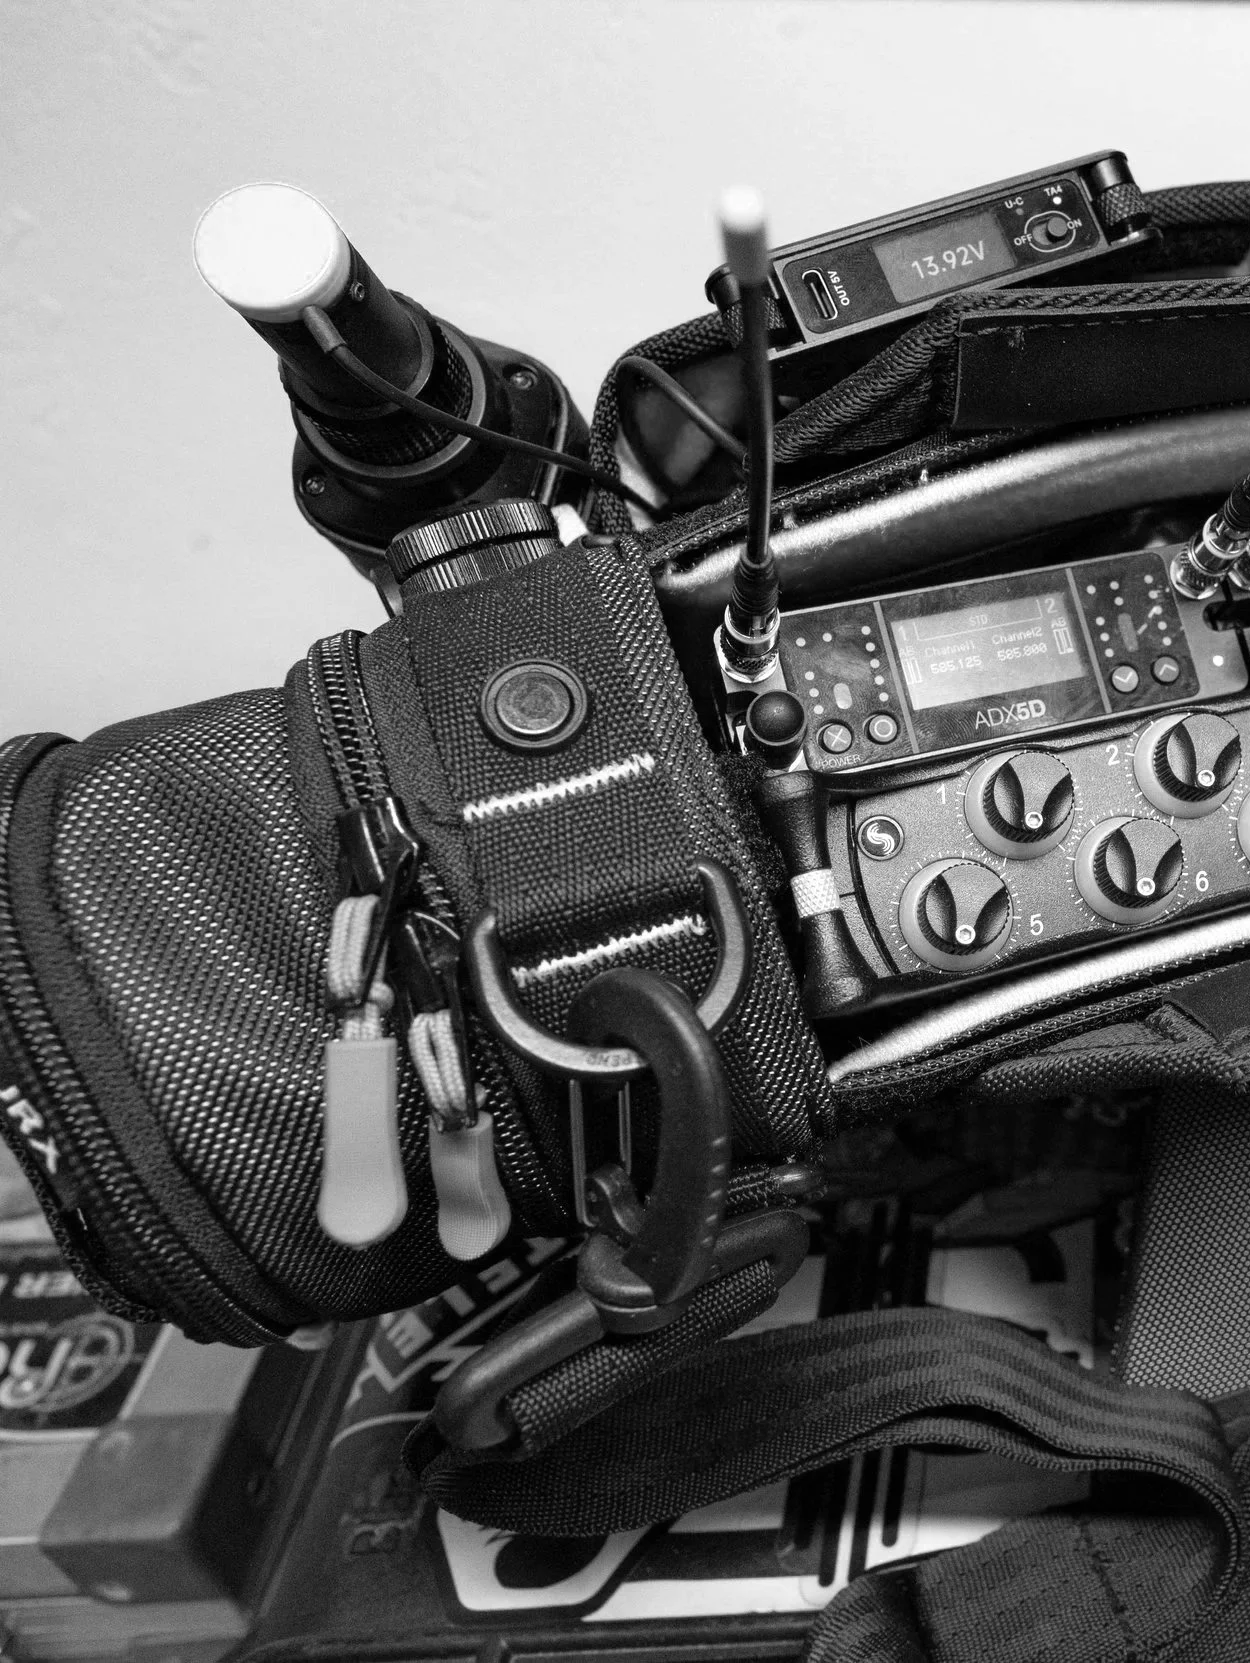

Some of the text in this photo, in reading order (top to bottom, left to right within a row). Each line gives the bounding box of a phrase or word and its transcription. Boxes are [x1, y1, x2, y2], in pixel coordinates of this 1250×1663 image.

[1043, 184, 1063, 197] TA4
[1004, 196, 1024, 210] U-C
[1066, 218, 1083, 230] ON
[1013, 233, 1033, 247] OFF
[911, 240, 985, 280] 13.92V
[833, 283, 850, 307] OUT
[968, 614, 988, 626] STD
[1044, 598, 1058, 614] 2
[991, 626, 1043, 645] Channel2
[930, 655, 983, 674] 585.125
[975, 699, 1046, 730] ADX5D
[821, 754, 861, 768] POWER
[1105, 744, 1120, 766] 2
[936, 784, 946, 805] 1
[1195, 870, 1210, 892] 6
[1029, 913, 1044, 936] 5
